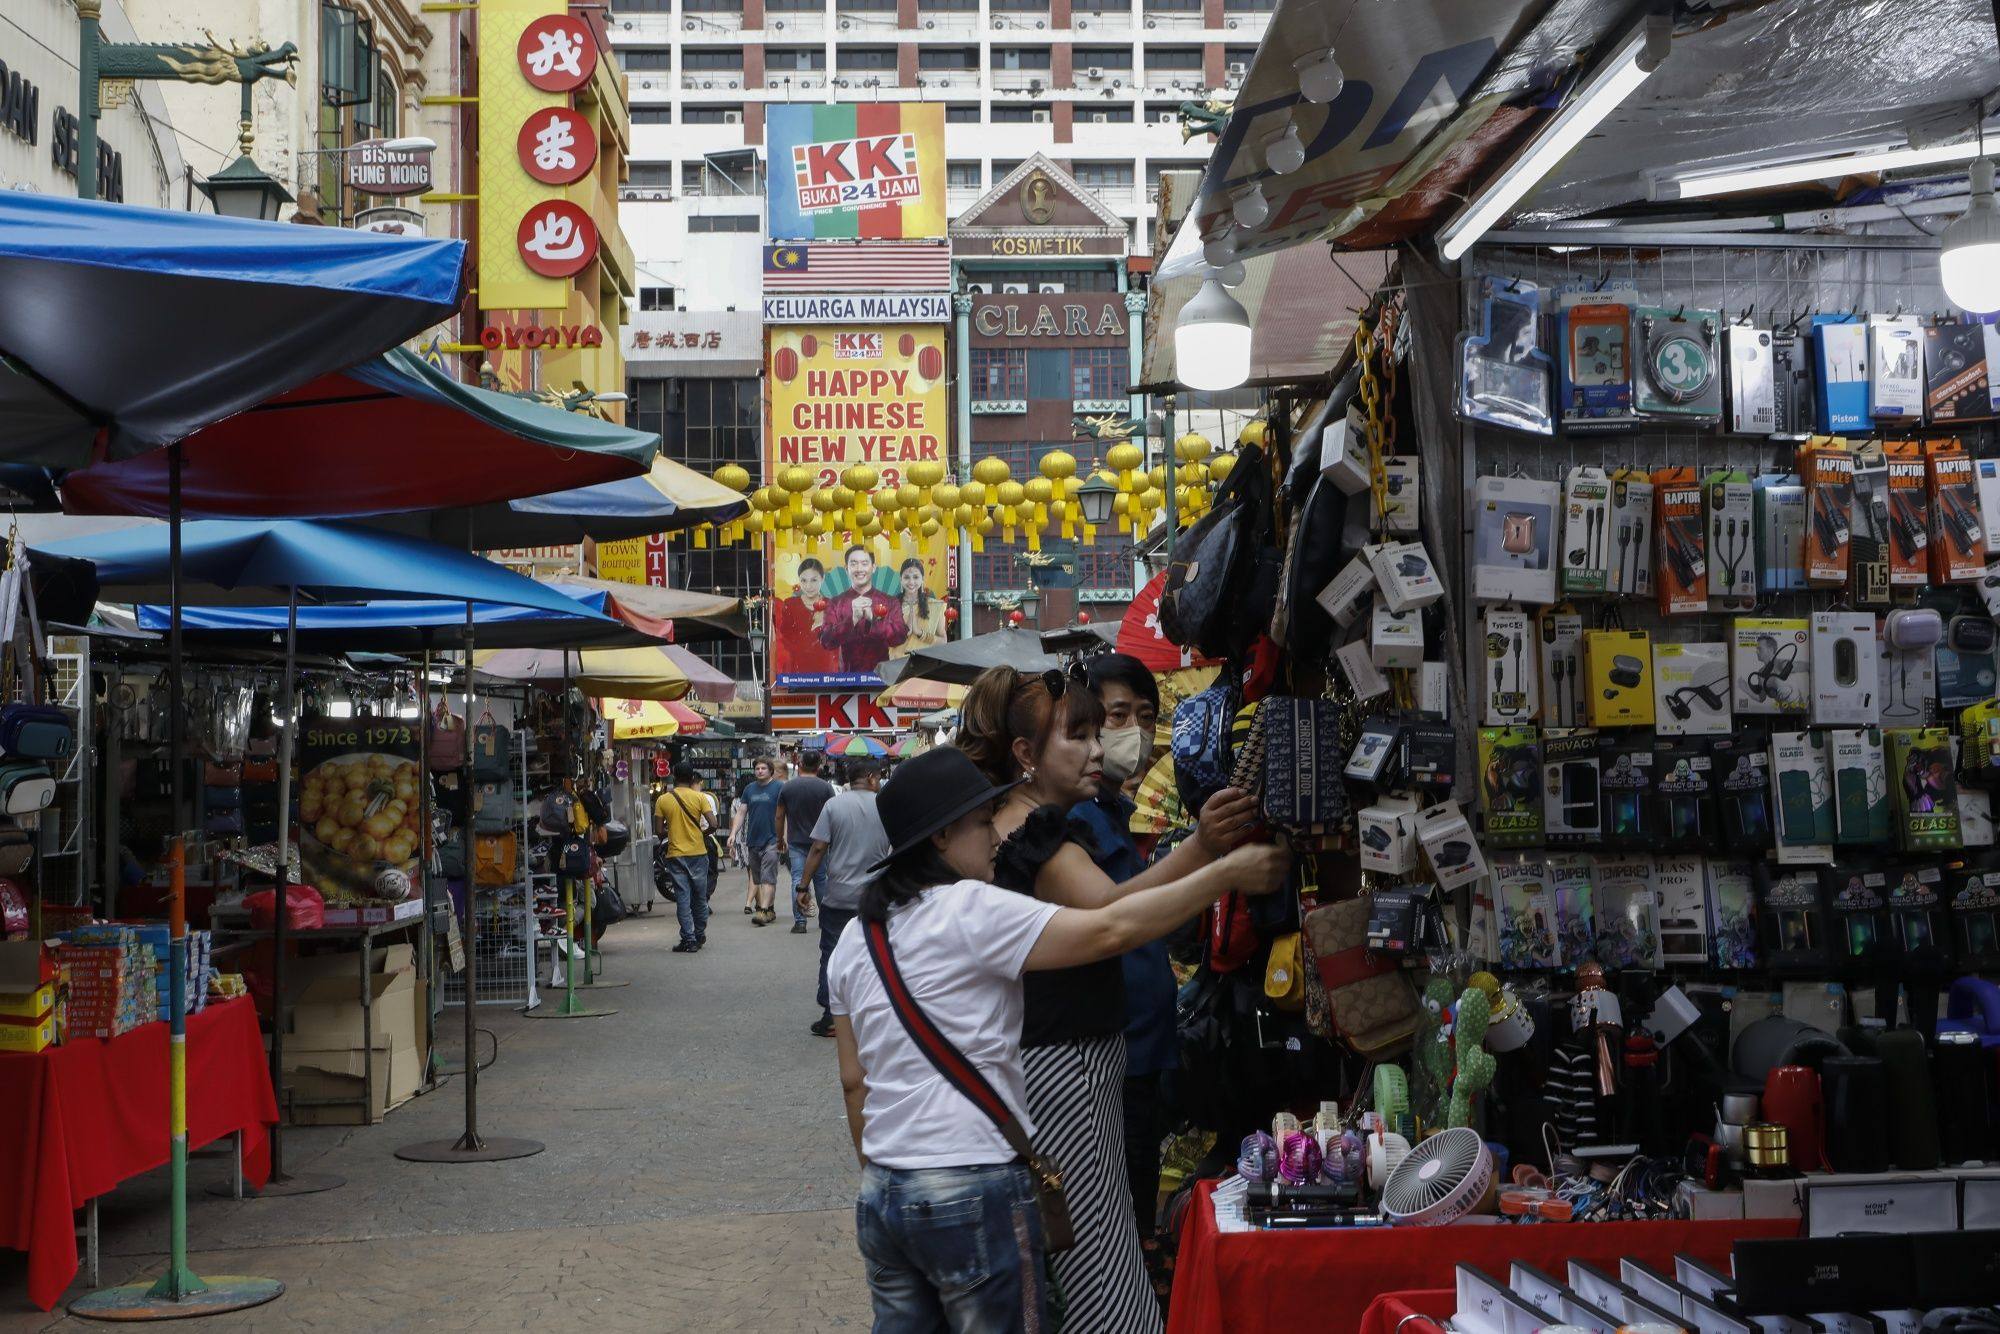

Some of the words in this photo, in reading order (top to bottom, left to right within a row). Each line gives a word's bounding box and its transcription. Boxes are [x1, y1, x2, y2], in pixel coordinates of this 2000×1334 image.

[808, 136, 902, 185] KK
[350, 165, 385, 184] FUNG
[390, 165, 428, 184] WONG
[801, 187, 839, 206] BUKA
[842, 183, 876, 201] 24
[881, 178, 918, 196] JAM
[842, 202, 887, 212] CONVENIENCE
[992, 238, 1084, 254] KOSMETIK
[764, 299, 856, 319] KELUARGA
[861, 298, 948, 318] MALAYSIA
[975, 304, 1125, 337] CLARA
[839, 333, 877, 350] KK
[851, 350, 865, 358] 24
[867, 350, 882, 358] JAM
[1662, 344, 1701, 384] 3M
[807, 370, 909, 397] HAPPY
[792, 402, 925, 430] CHINESE
[1753, 415, 1773, 423] HEADSET
[1832, 414, 1859, 423] Piston
[780, 435, 846, 463] NEW
[858, 434, 939, 462] YEAR
[1816, 459, 1852, 472] RAPTOR
[1889, 465, 1925, 477] RAPTOR
[1935, 460, 1971, 473] RAPTOR
[1664, 491, 1701, 504] RAPTOR
[603, 544, 638, 555] TOWN
[601, 559, 640, 569] BOUTIQUE
[1868, 564, 1887, 587] 1.5
[818, 693, 894, 728] KK
[307, 729, 358, 746] Since
[365, 726, 411, 745] 1973
[1299, 718, 1312, 769] CHRISTIAN
[1545, 737, 1598, 754] PRIVACY
[1300, 773, 1312, 796] DIOR
[1659, 782, 1686, 790] PRIVACY
[1686, 781, 1708, 789] GLASS
[1489, 814, 1539, 829] GLASS
[1909, 817, 1957, 831] GLASS
[1495, 863, 1544, 881] TEMPERED
[1660, 876, 1689, 885] PRO+
